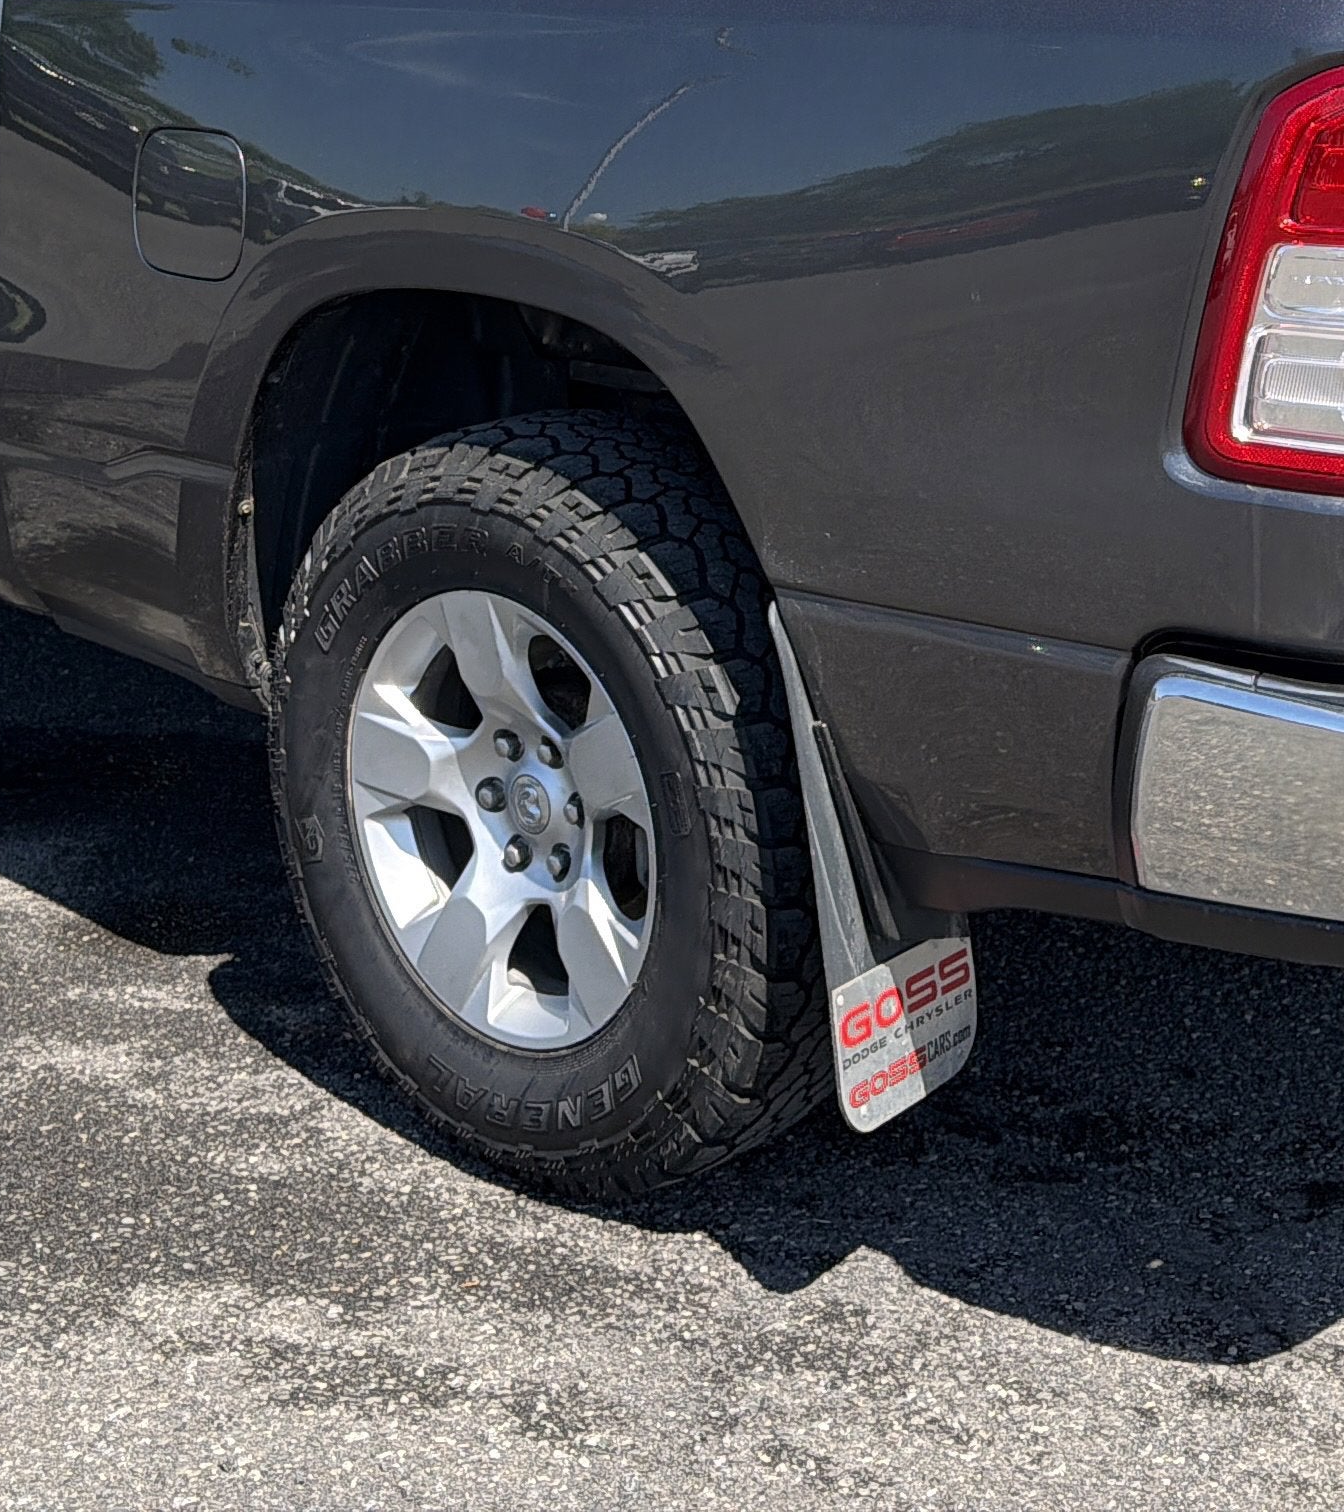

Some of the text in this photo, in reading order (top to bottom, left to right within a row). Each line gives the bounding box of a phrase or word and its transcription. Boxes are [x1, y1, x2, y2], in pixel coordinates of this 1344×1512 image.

[313, 524, 490, 654] GRABBER
[840, 947, 971, 1049] GOSS
[842, 988, 973, 1071] DODGE CHRYSLER
[427, 1053, 643, 1132] GENERAL
